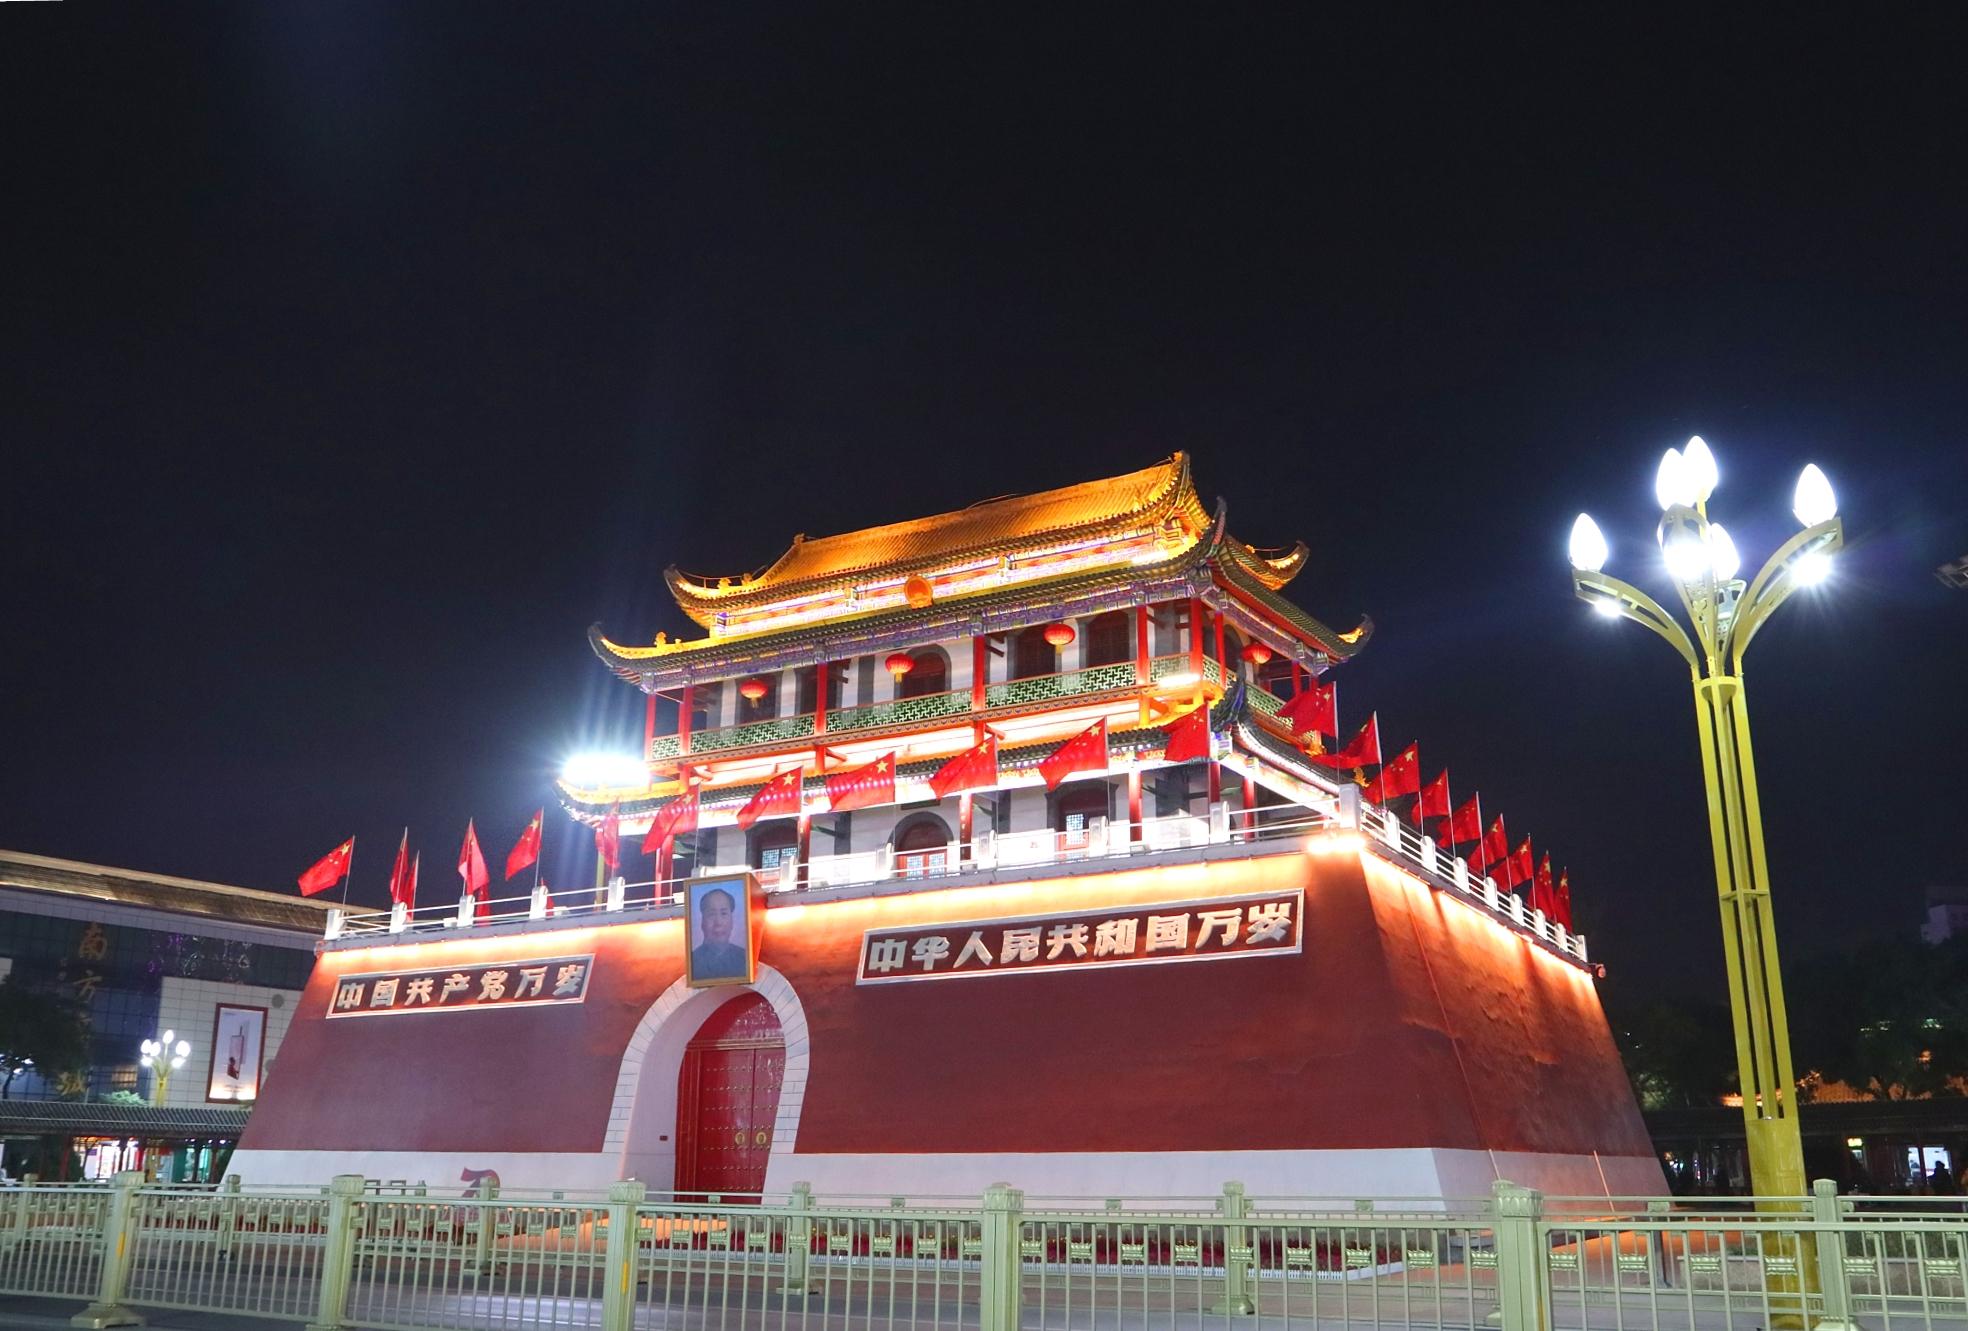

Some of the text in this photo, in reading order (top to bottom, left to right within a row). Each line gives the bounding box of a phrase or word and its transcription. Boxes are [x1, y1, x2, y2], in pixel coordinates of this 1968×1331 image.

[868, 902, 1293, 973] 中华人民共和国万岁
[336, 964, 586, 1009] 中国共产党万岁
